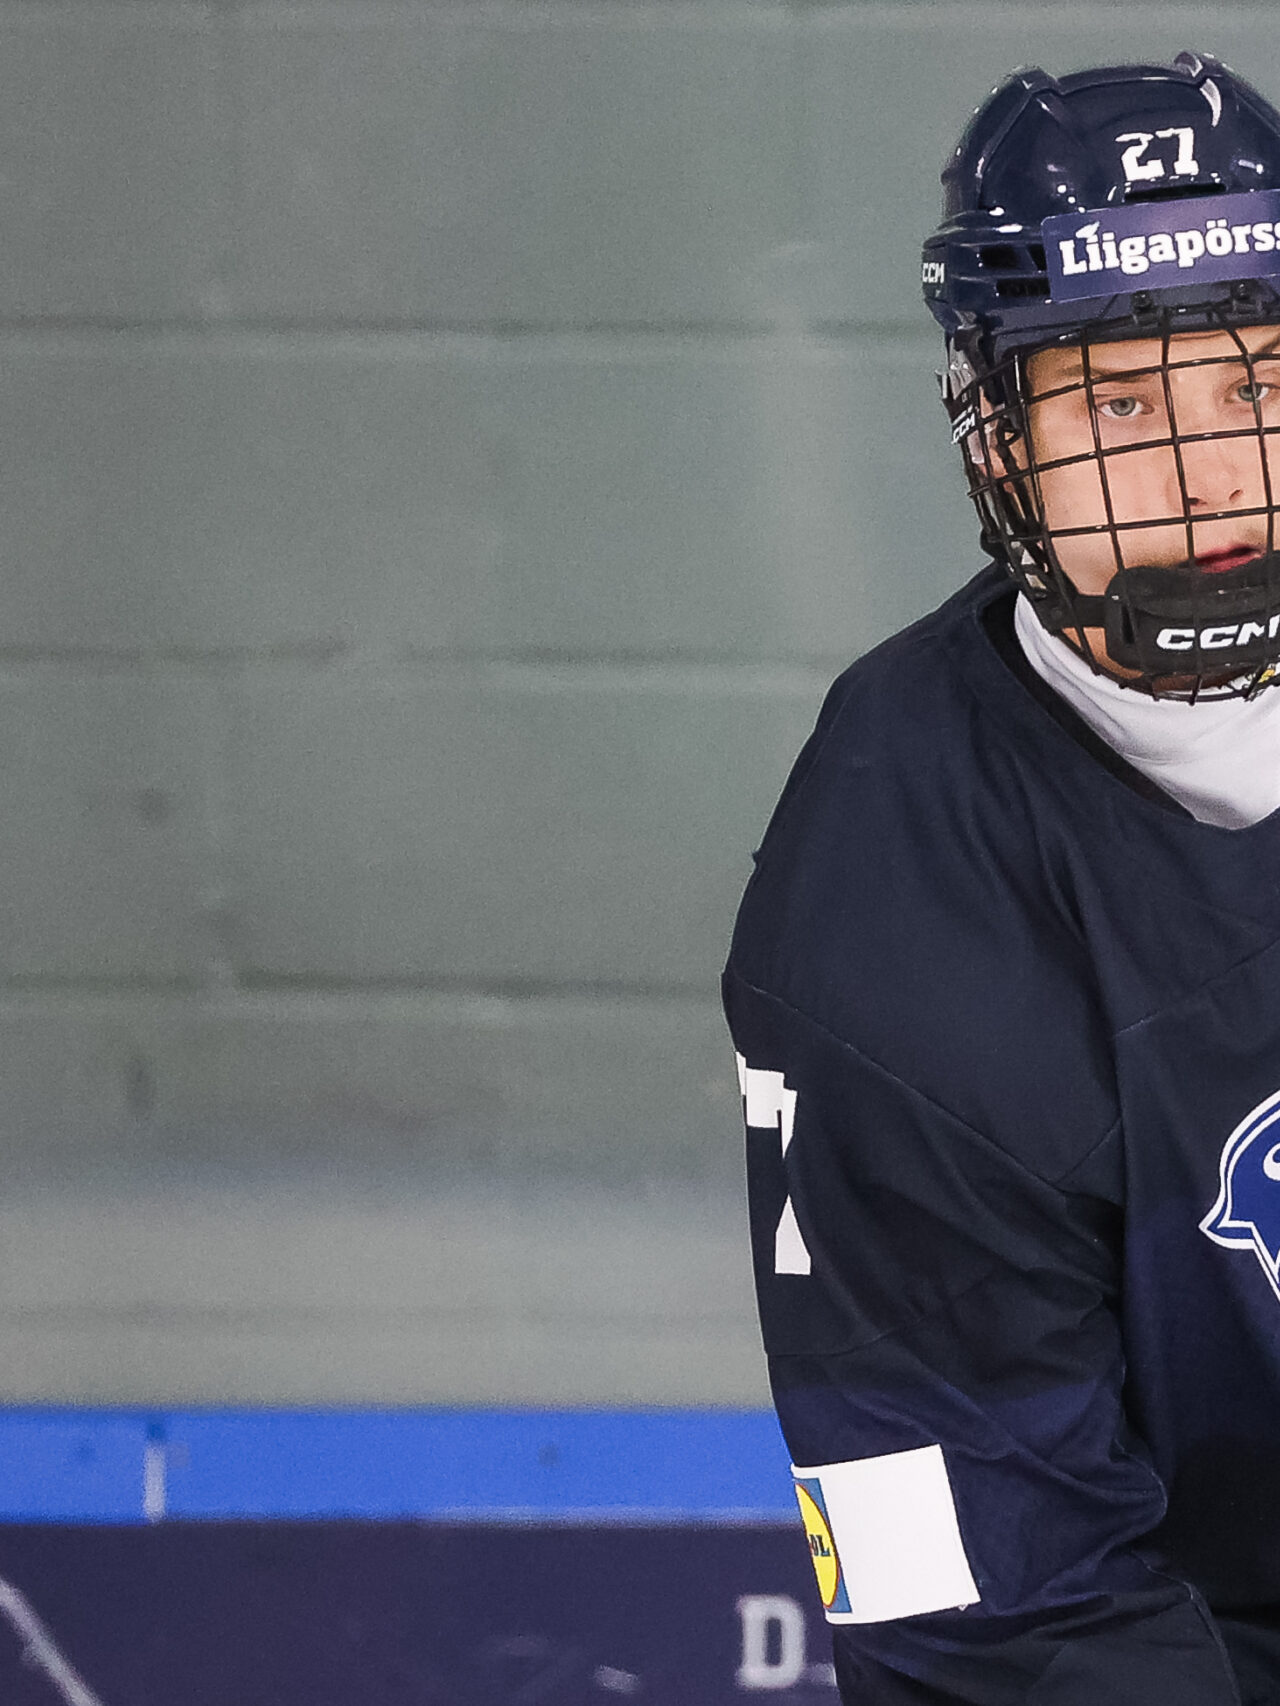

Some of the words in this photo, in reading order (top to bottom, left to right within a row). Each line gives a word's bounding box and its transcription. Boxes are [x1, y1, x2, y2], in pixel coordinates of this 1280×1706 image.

[1115, 126, 1199, 181] 27
[922, 262, 945, 284] CCM
[1156, 614, 1280, 651] CCM
